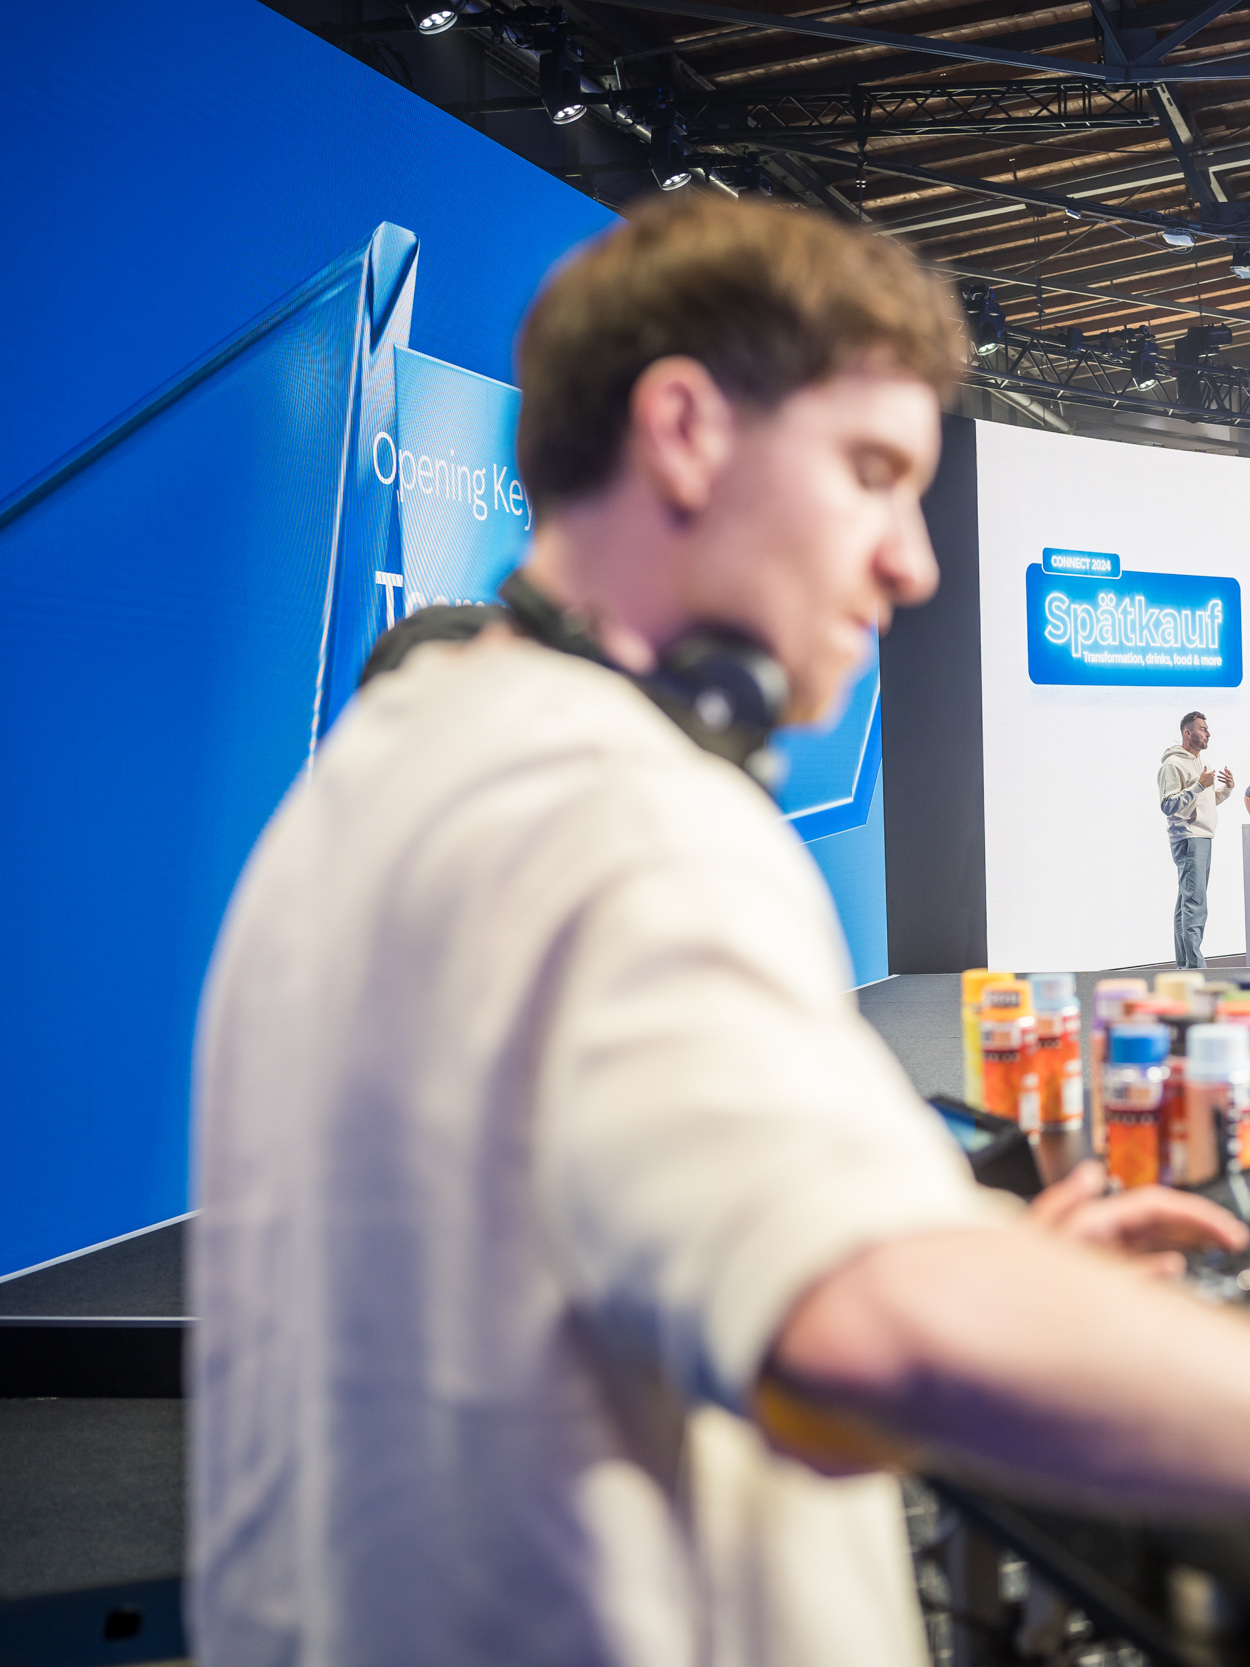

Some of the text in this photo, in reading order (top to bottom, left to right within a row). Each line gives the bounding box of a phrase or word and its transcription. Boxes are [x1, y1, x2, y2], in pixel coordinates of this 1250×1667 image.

[373, 431, 488, 521] Opening
[1051, 555, 1111, 571] CONNECT 2024
[1044, 593, 1222, 657] Spätkauf
[1083, 651, 1222, 667] Transformation, drinks, food & more
